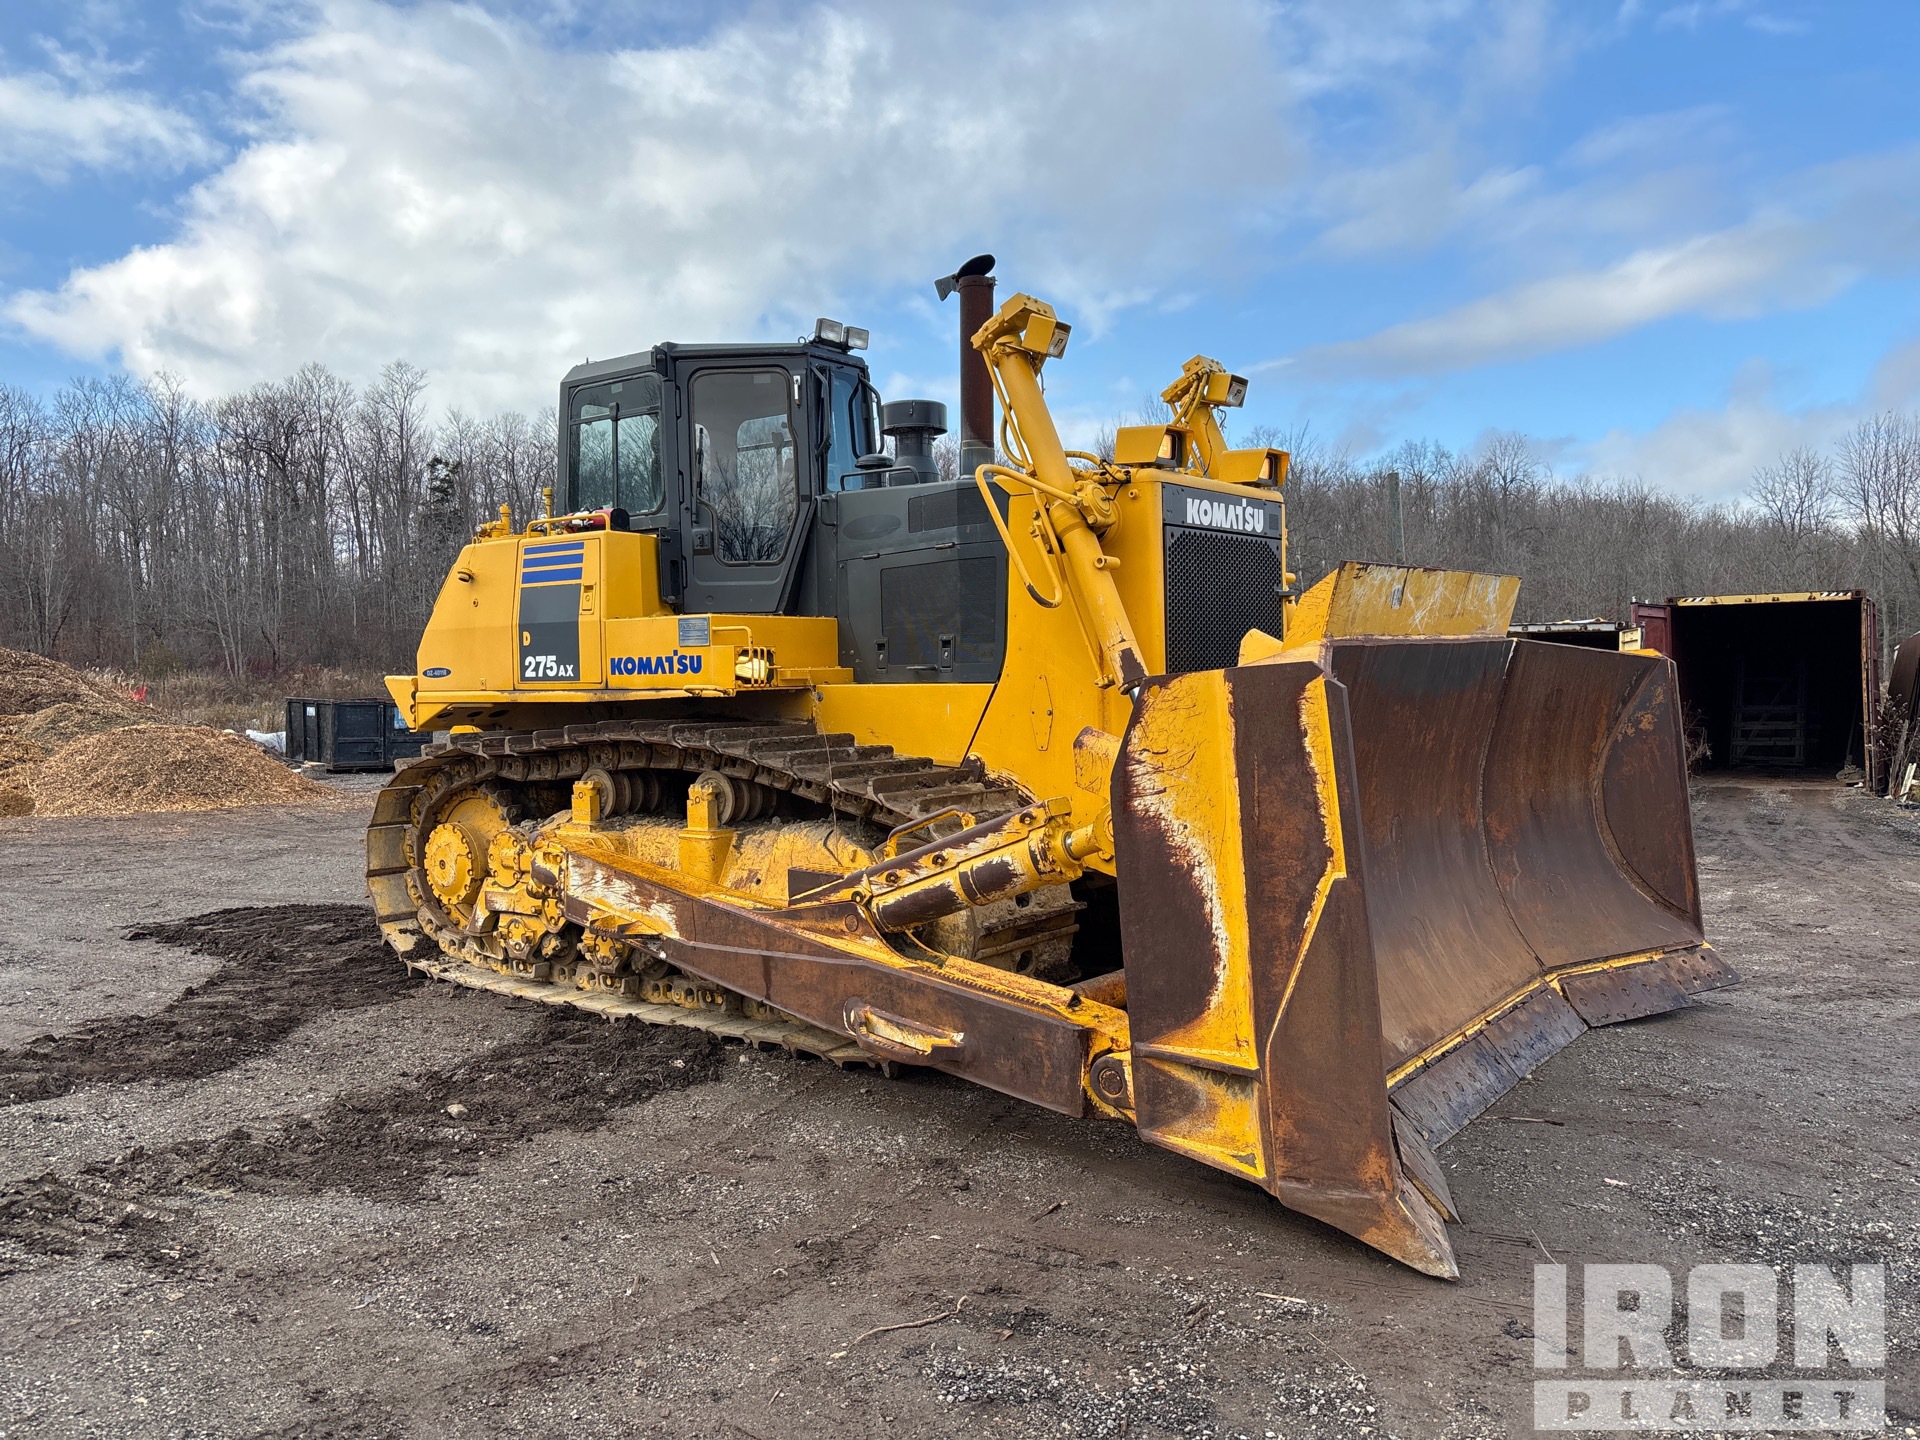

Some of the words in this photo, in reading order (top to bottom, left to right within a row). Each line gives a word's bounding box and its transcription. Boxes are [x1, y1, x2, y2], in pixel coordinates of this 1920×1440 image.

[1186, 498, 1264, 533] KOMATSU
[522, 631, 531, 646] D
[610, 649, 702, 676] KOMATSU
